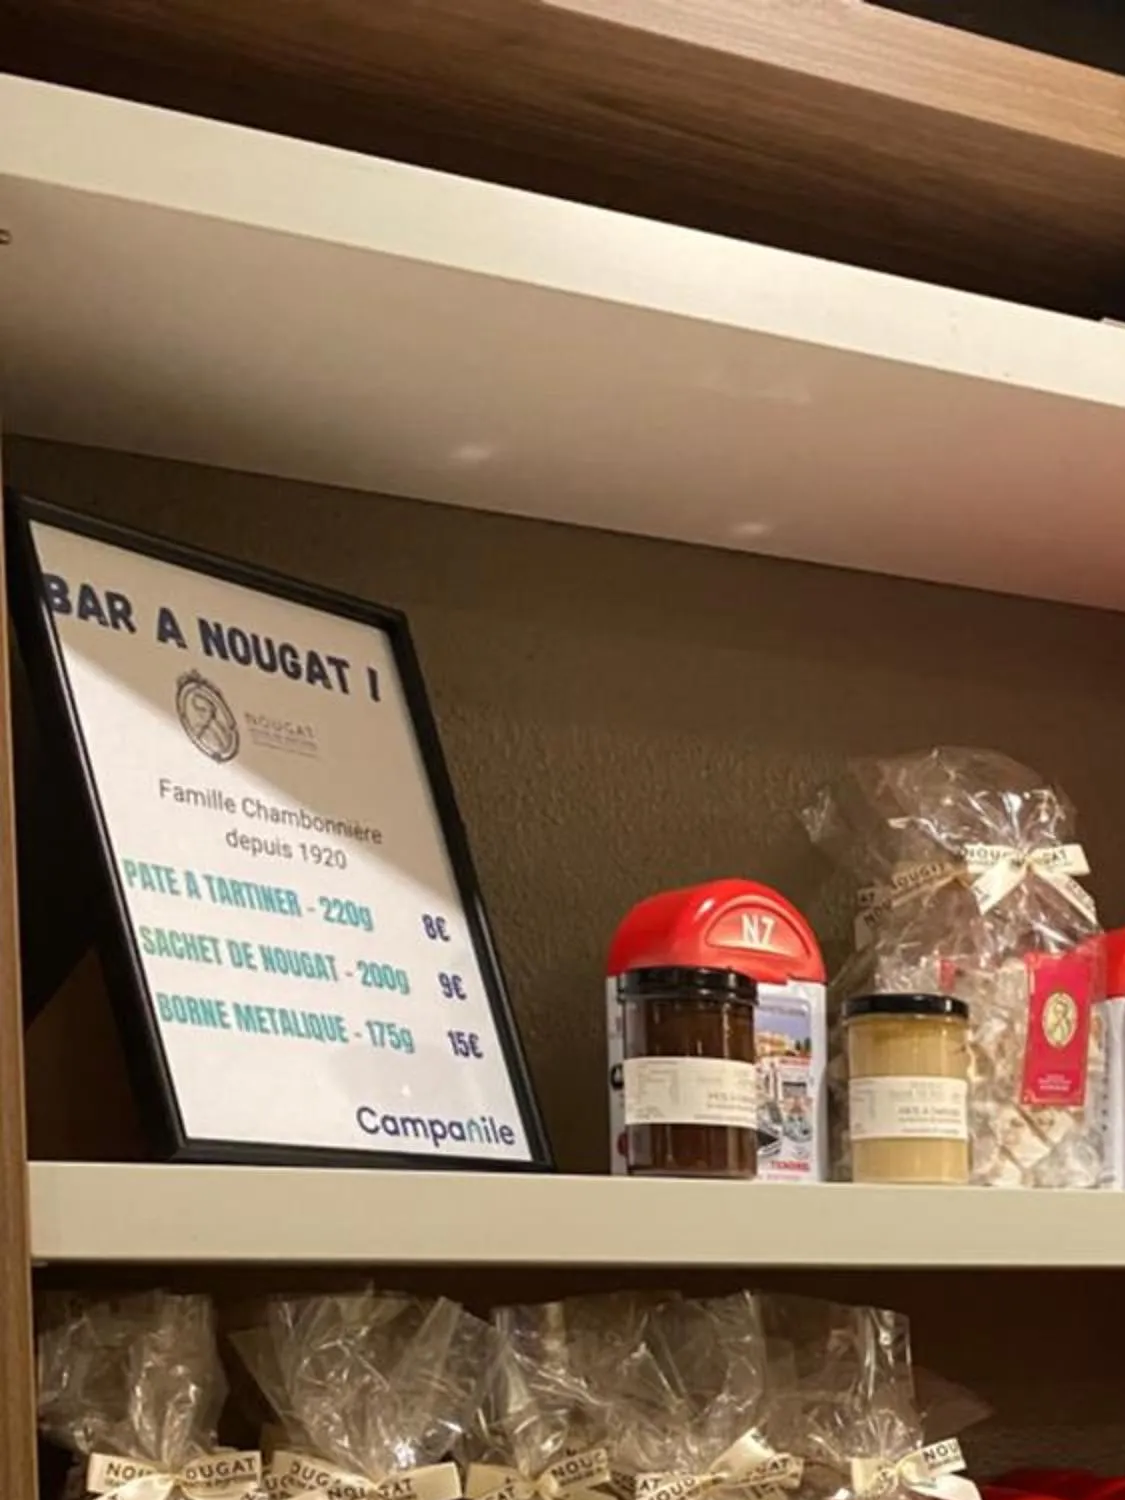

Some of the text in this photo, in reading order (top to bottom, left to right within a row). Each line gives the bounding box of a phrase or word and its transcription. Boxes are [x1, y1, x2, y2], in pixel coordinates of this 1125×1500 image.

[42, 572, 136, 633] BAR
[157, 607, 187, 650] A
[199, 617, 350, 694] NOUGAT
[158, 778, 383, 845] Famille Chambonnière
[225, 828, 347, 870] depuis 1920
[122, 857, 181, 897] PATE
[186, 870, 200, 898] A
[202, 873, 302, 919] TARTINER
[320, 895, 374, 933] 220g
[422, 913, 451, 943] 8€
[741, 911, 775, 946] N7
[138, 924, 225, 967] SACHET
[229, 941, 256, 972] DE
[258, 944, 340, 984] NOUGAT
[357, 959, 411, 996] 200g
[438, 971, 467, 1001] 9€
[156, 991, 231, 1031] BORNE
[233, 1000, 350, 1045] METALIQUE
[367, 1019, 415, 1055] 175g
[446, 1030, 485, 1061] 15€
[355, 1105, 516, 1148] Campanile
[186, 1457, 257, 1480] OUGAT
